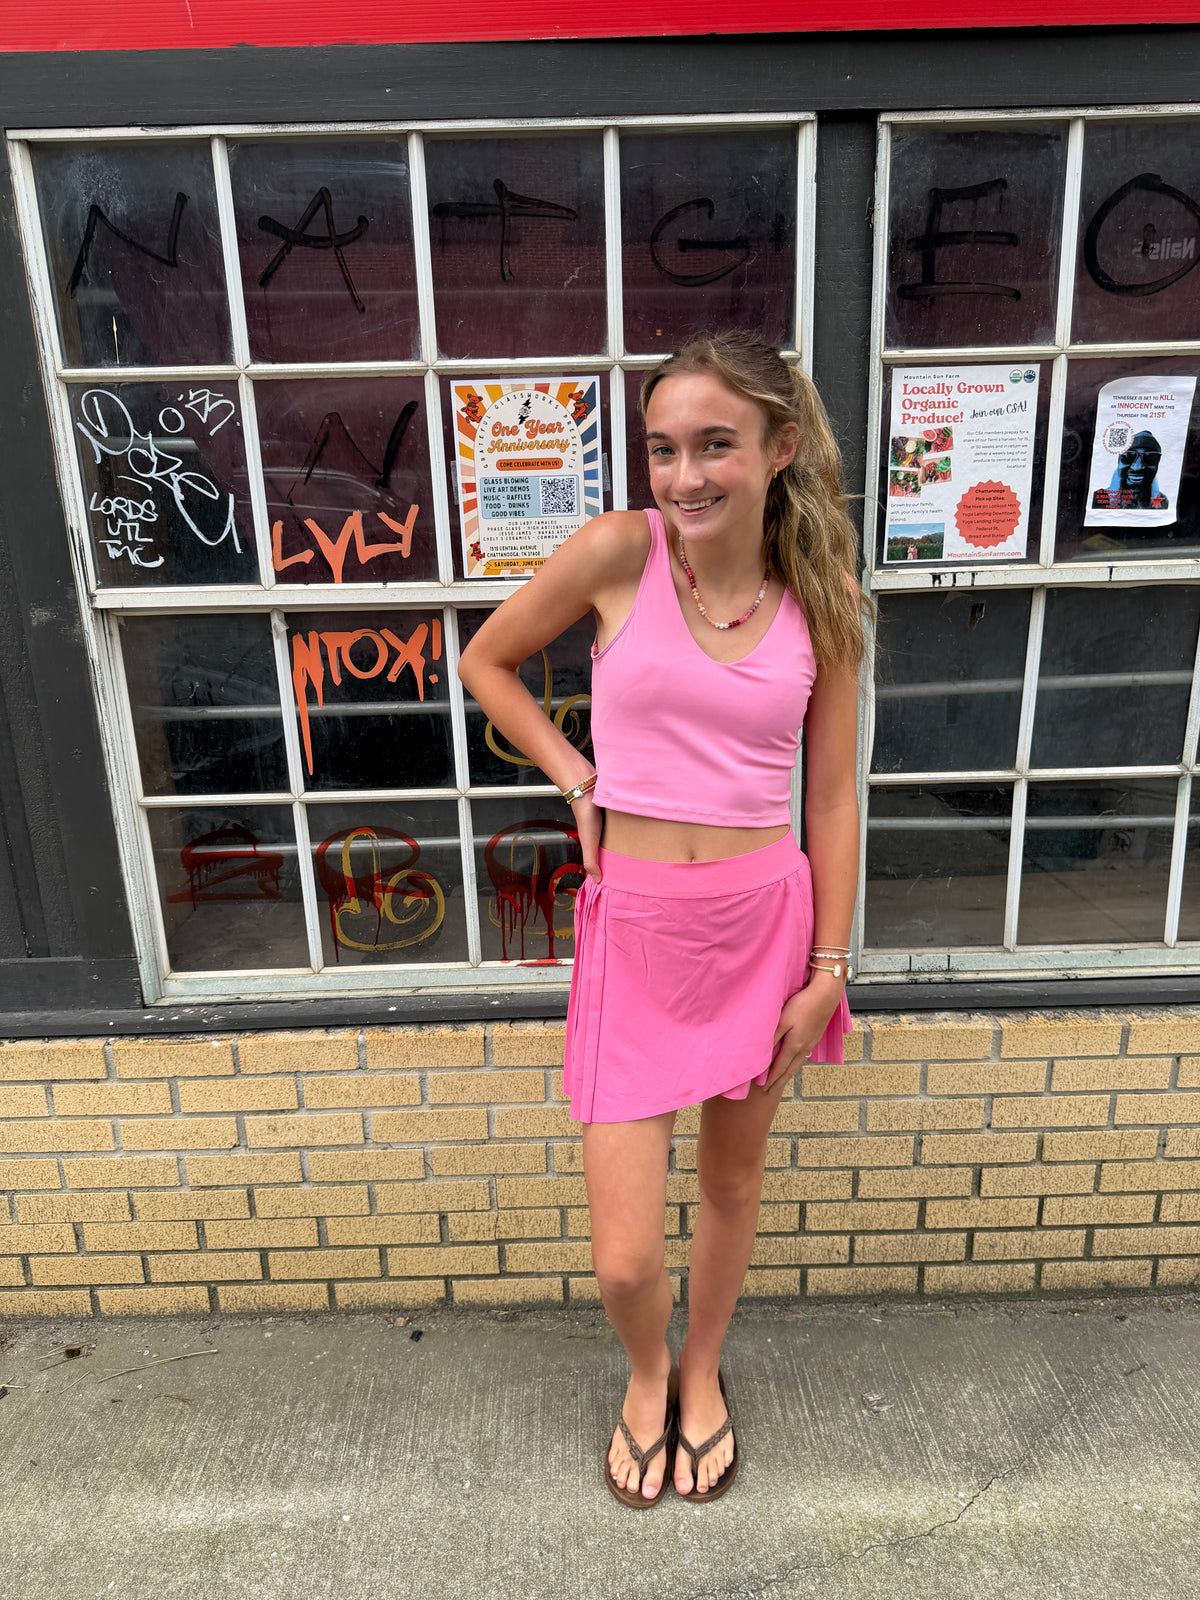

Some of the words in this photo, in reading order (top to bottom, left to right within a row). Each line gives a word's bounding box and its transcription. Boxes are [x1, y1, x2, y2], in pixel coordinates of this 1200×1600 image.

[903, 383, 953, 396] Locally
[957, 382, 1005, 394] Grown
[901, 398, 959, 412] Organic
[970, 409, 988, 419] Join
[989, 408, 1005, 416] our
[1006, 400, 1027, 415] CSA!
[901, 411, 964, 425] Produce!
[491, 421, 520, 437] One
[524, 419, 565, 439] Year
[487, 438, 570, 453] Anniversary
[90, 492, 159, 522] LORDS
[947, 551, 1021, 559] MountainSunFarm.com
